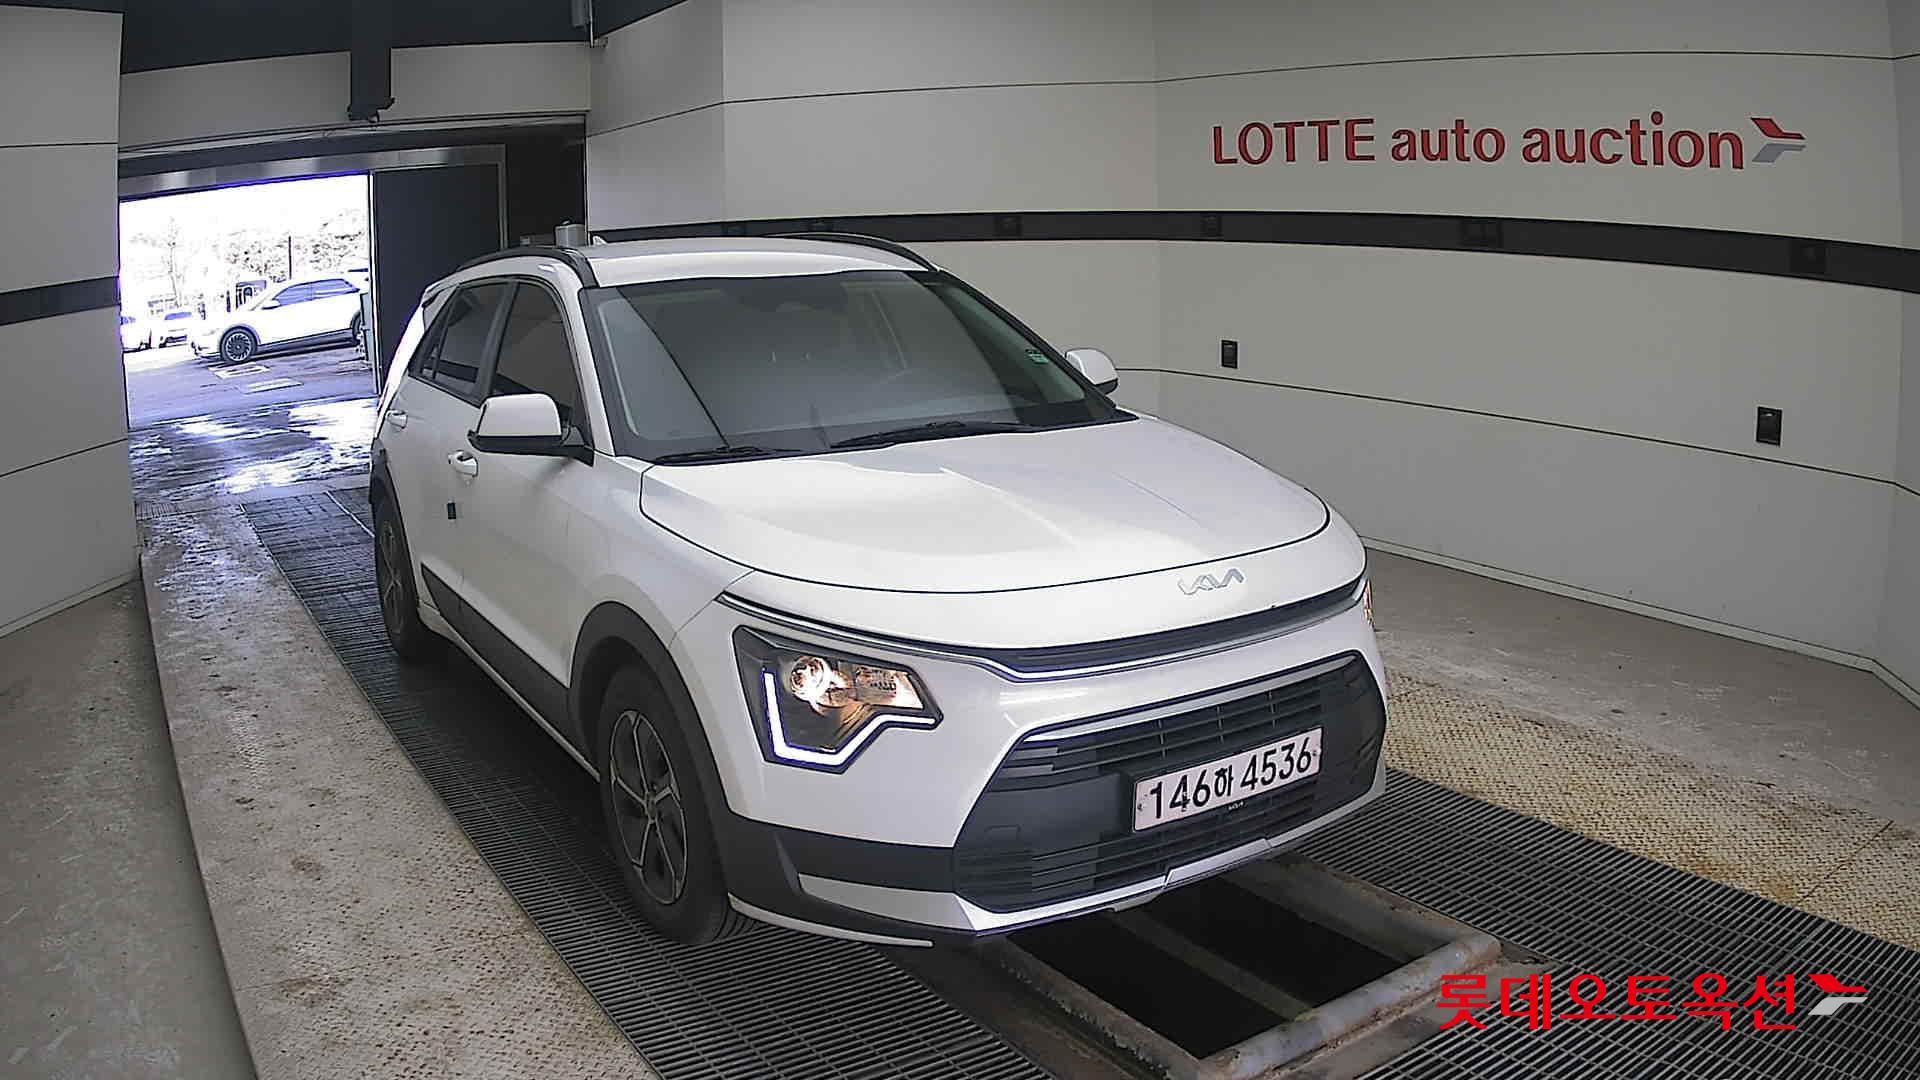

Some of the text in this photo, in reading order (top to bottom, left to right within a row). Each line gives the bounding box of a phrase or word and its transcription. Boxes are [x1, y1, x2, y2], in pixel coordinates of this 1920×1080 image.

[1211, 111, 1745, 170] LOTTE auto auction
[1150, 736, 1313, 819] 146하 4536
